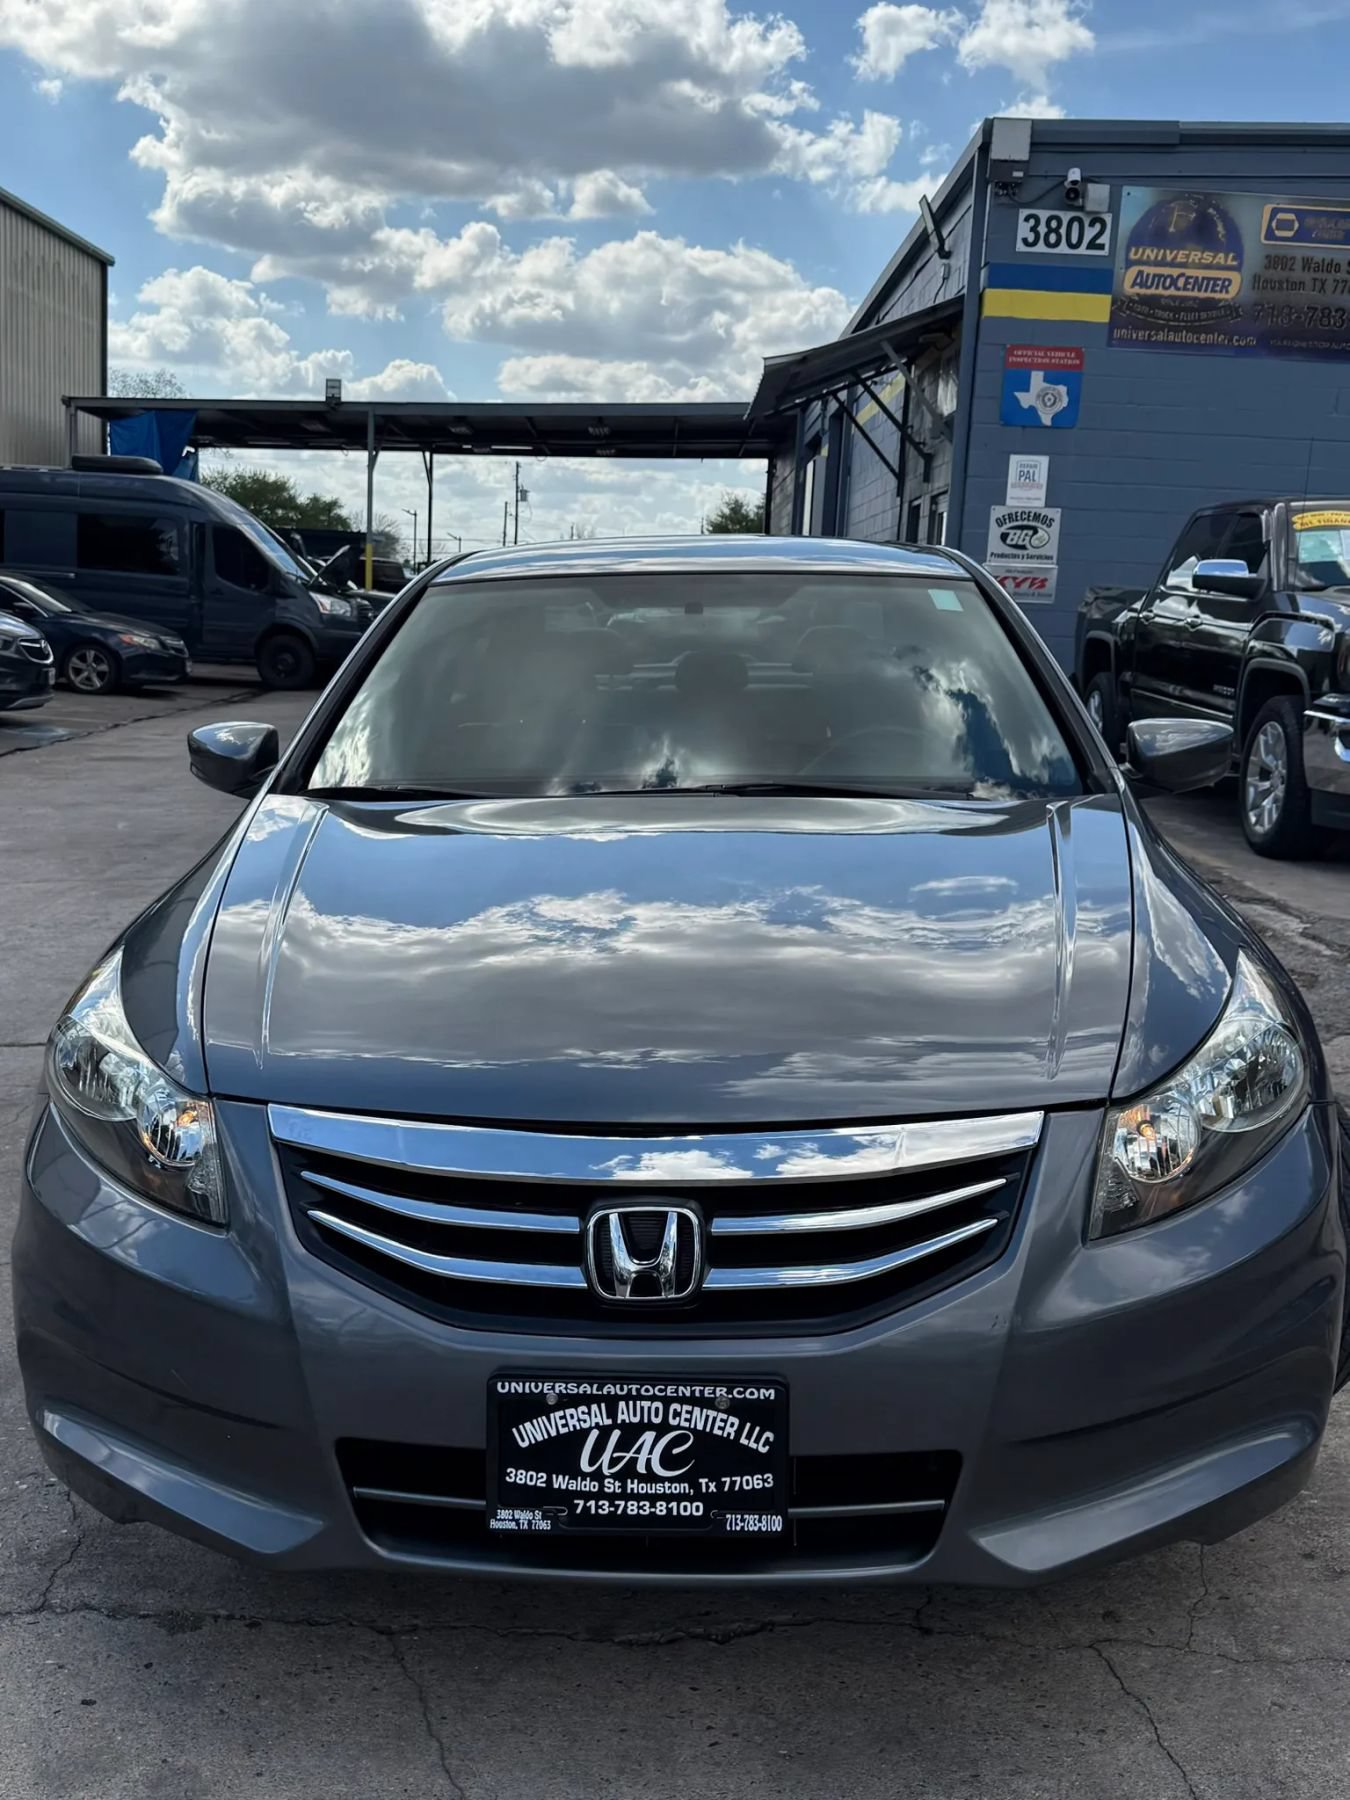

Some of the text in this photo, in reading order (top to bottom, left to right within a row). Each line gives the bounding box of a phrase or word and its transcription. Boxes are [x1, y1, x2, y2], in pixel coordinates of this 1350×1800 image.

[1021, 213, 1108, 251] 3802
[1128, 247, 1239, 266] UNIVERSAL
[1264, 255, 1296, 272] 3802
[1302, 257, 1341, 274] Waldo
[1252, 273, 1350, 296] Houston TX 77
[1113, 325, 1256, 346] universalautocenter.com
[1018, 469, 1037, 482] PAL
[995, 510, 1055, 528] OFRECEMOS
[1005, 529, 1033, 545] BG
[990, 551, 1020, 560] Productos
[1026, 553, 1054, 561] Servicios
[497, 1382, 776, 1399] UNIVERSALAUTOCENTER.COM
[512, 1400, 774, 1454] UNIVERSAL AUTO CENTER LLC
[580, 1428, 695, 1477] UAC
[505, 1468, 774, 1495] 3802 Waldo St Houston, Tx 77063
[496, 1509, 542, 1521] 3802 Waldo St
[573, 1500, 704, 1516] 713-783-8100
[490, 1519, 551, 1530] Houston, TX 77063
[726, 1514, 783, 1532] 713-783-8100
